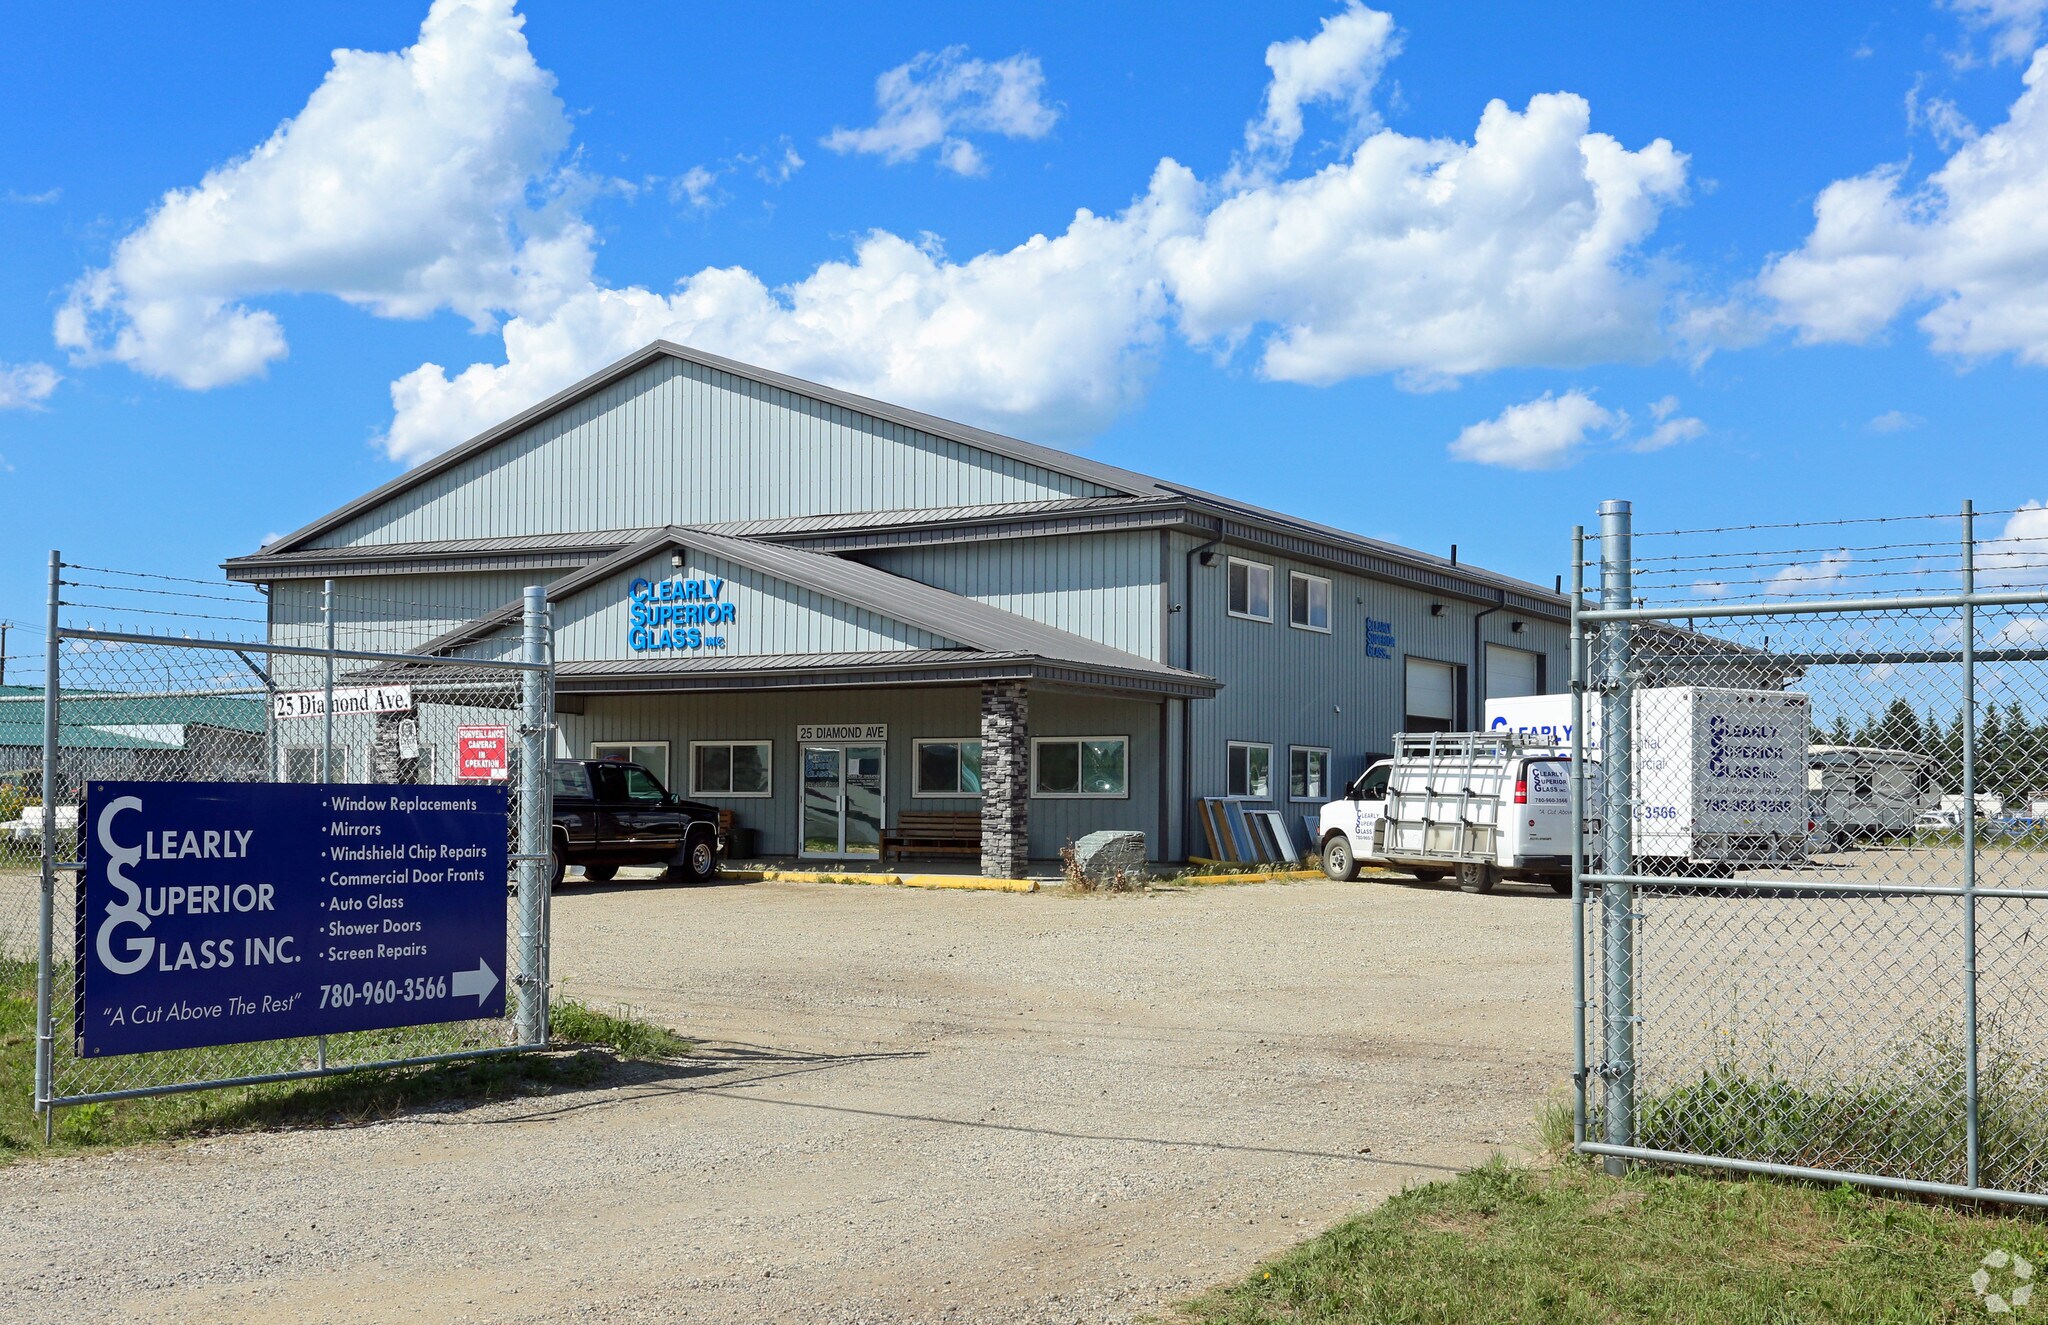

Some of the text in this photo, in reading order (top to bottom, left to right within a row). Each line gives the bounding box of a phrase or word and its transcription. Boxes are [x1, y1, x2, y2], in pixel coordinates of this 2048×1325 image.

[629, 577, 724, 602] CLEARLY
[629, 601, 736, 626] SUPERIOR
[628, 625, 702, 650] GLASS
[277, 694, 294, 716] 25
[374, 689, 408, 710] Ave.
[459, 729, 504, 739] SURVEILLANCE
[800, 726, 884, 739] 25 DIAMOND AVE
[468, 740, 497, 749] CAMERAS
[465, 759, 500, 768] OPERATION
[1532, 768, 1563, 778] CLEARLY
[1533, 775, 1567, 785] SUPERIOR
[1534, 783, 1559, 792] GLASS
[331, 795, 477, 814] Window Replacements
[97, 795, 254, 859] CLEARLY
[330, 821, 382, 836] Mirrors
[330, 843, 487, 861] Windshield Chip Repairs
[104, 856, 275, 916] SUPERIOR
[329, 867, 485, 886] Commercial Door Fronts
[328, 893, 404, 911] Auto Glass
[328, 918, 422, 936] Shower Doors
[96, 910, 301, 975] GLASS INC.
[328, 942, 427, 961] Screen Repairs
[319, 975, 447, 1010] 780-960-3566
[131, 1004, 163, 1025] Cut
[165, 1000, 222, 1021] Above
[228, 995, 256, 1016] The
